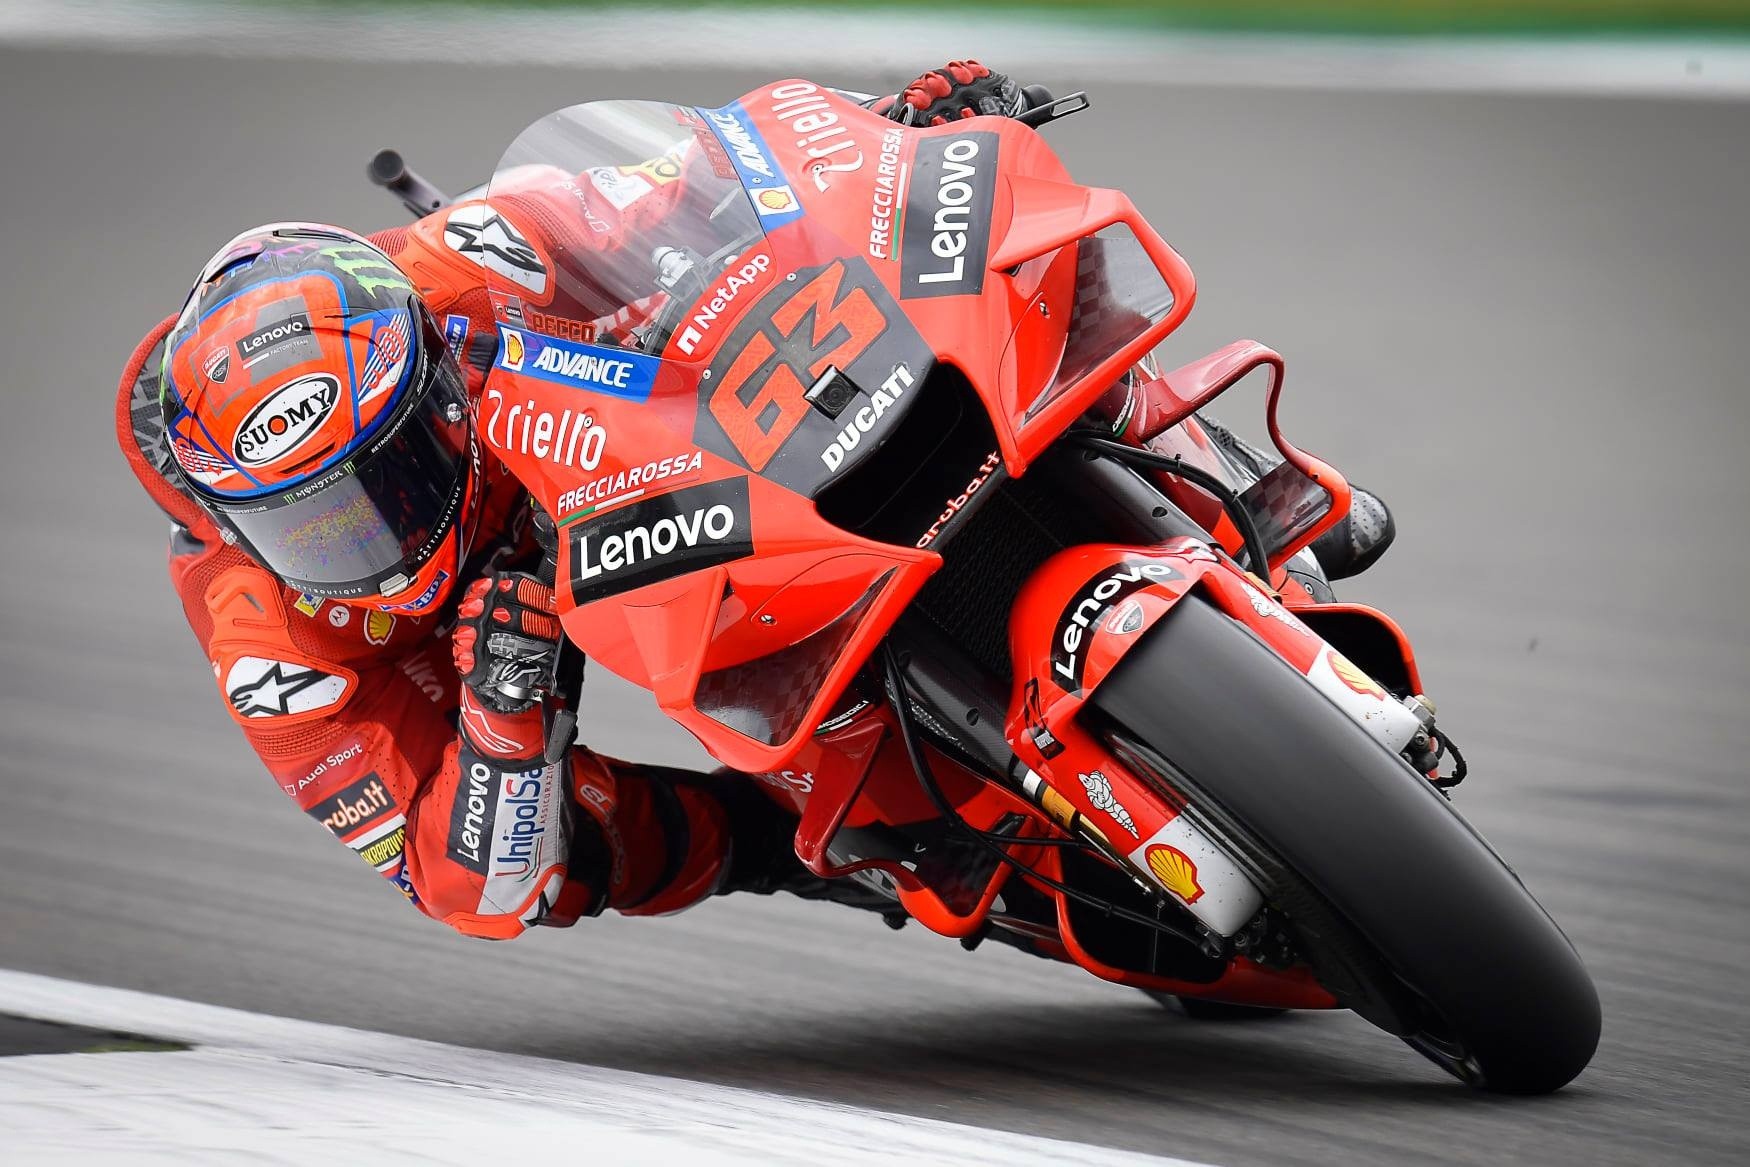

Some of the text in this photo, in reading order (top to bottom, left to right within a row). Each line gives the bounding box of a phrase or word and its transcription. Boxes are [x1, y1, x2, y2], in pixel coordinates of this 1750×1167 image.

[869, 127, 904, 259] FRECCIAROSSA
[918, 139, 979, 284] Lenovo
[532, 312, 596, 344] PECCO
[693, 253, 770, 331] NetApp
[242, 321, 303, 352] Lenovo
[532, 346, 634, 388] ADVANCE
[709, 260, 887, 473] 63
[239, 388, 331, 453] SUOMY
[820, 365, 915, 472] DUCATI
[557, 451, 702, 516] FRECCIAROSSA
[915, 450, 1001, 549] aruba.it
[580, 504, 735, 580] Lenovo
[1055, 564, 1172, 680] Lenovo
[298, 743, 363, 790] Audi Sport
[540, 765, 555, 824] ASSICURAZIO
[320, 780, 388, 834] ruba.it
[457, 763, 491, 862] Lenovo
[495, 768, 545, 877] UnipolSa
